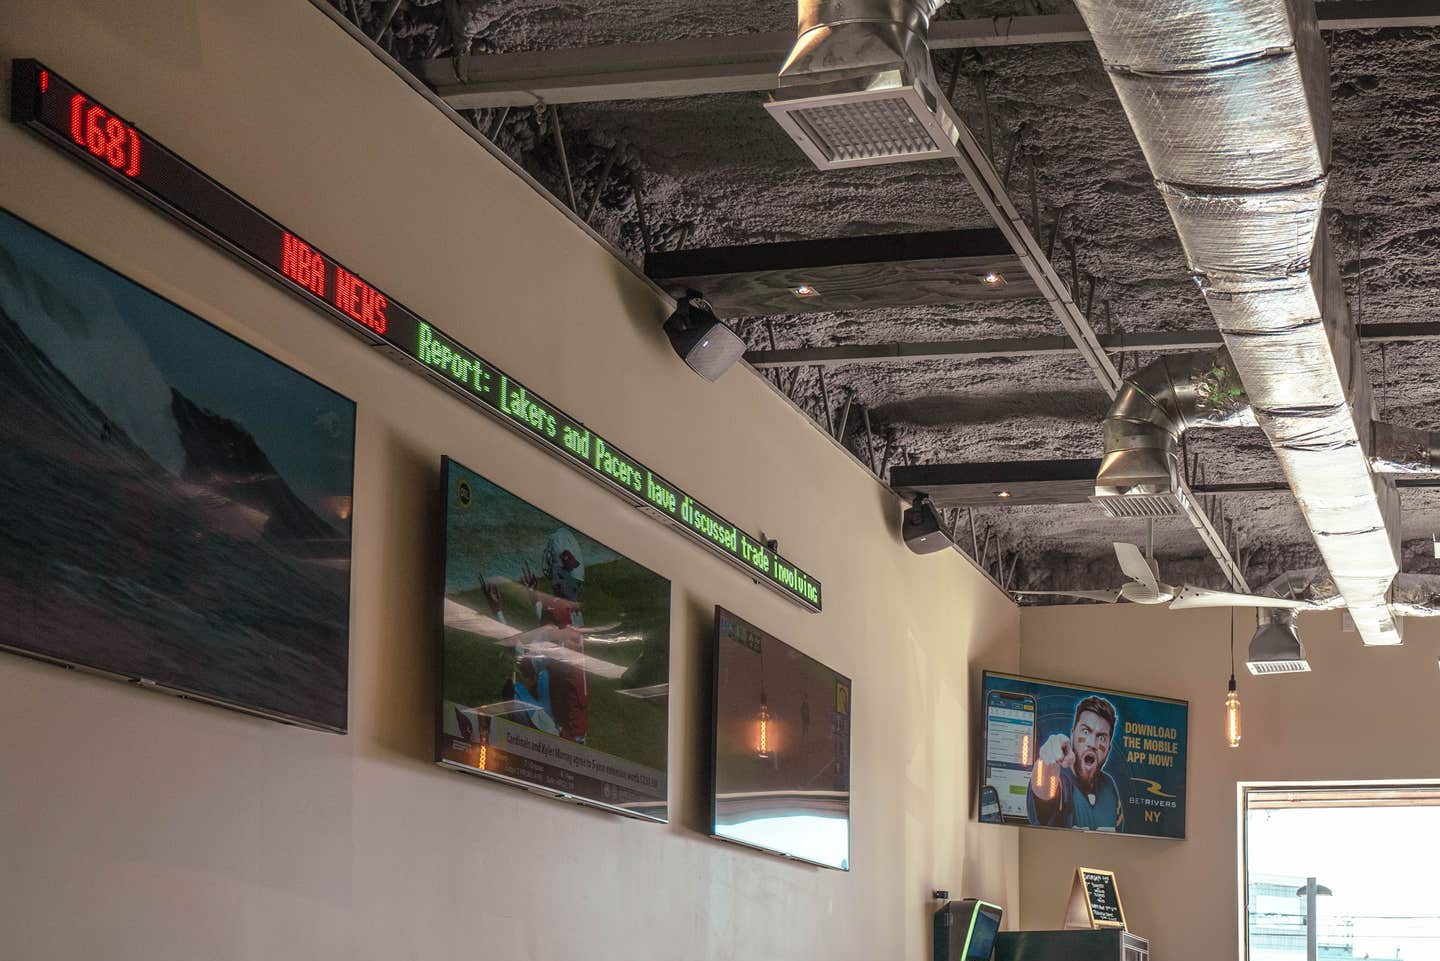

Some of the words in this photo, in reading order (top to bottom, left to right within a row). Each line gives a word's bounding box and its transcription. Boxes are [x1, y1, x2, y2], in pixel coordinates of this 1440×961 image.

[70, 93, 142, 177] (68)
[281, 231, 325, 297] NBA
[335, 266, 388, 335] NEWS
[417, 321, 491, 393] Report:
[499, 374, 557, 437] Lakers
[563, 424, 590, 459] and
[594, 437, 642, 492] Pacers
[647, 472, 677, 513] have
[681, 495, 737, 552] discussed
[741, 535, 769, 572] trade
[773, 554, 819, 604] involving
[1124, 721, 1177, 740] DOWNLOAD
[1123, 736, 1141, 750] THE
[1143, 738, 1178, 755] MOBILE
[1127, 753, 1146, 764] APP
[1148, 754, 1174, 768] NOW!
[1128, 796, 1177, 809] BETRIVERS
[1144, 810, 1161, 824] NY
